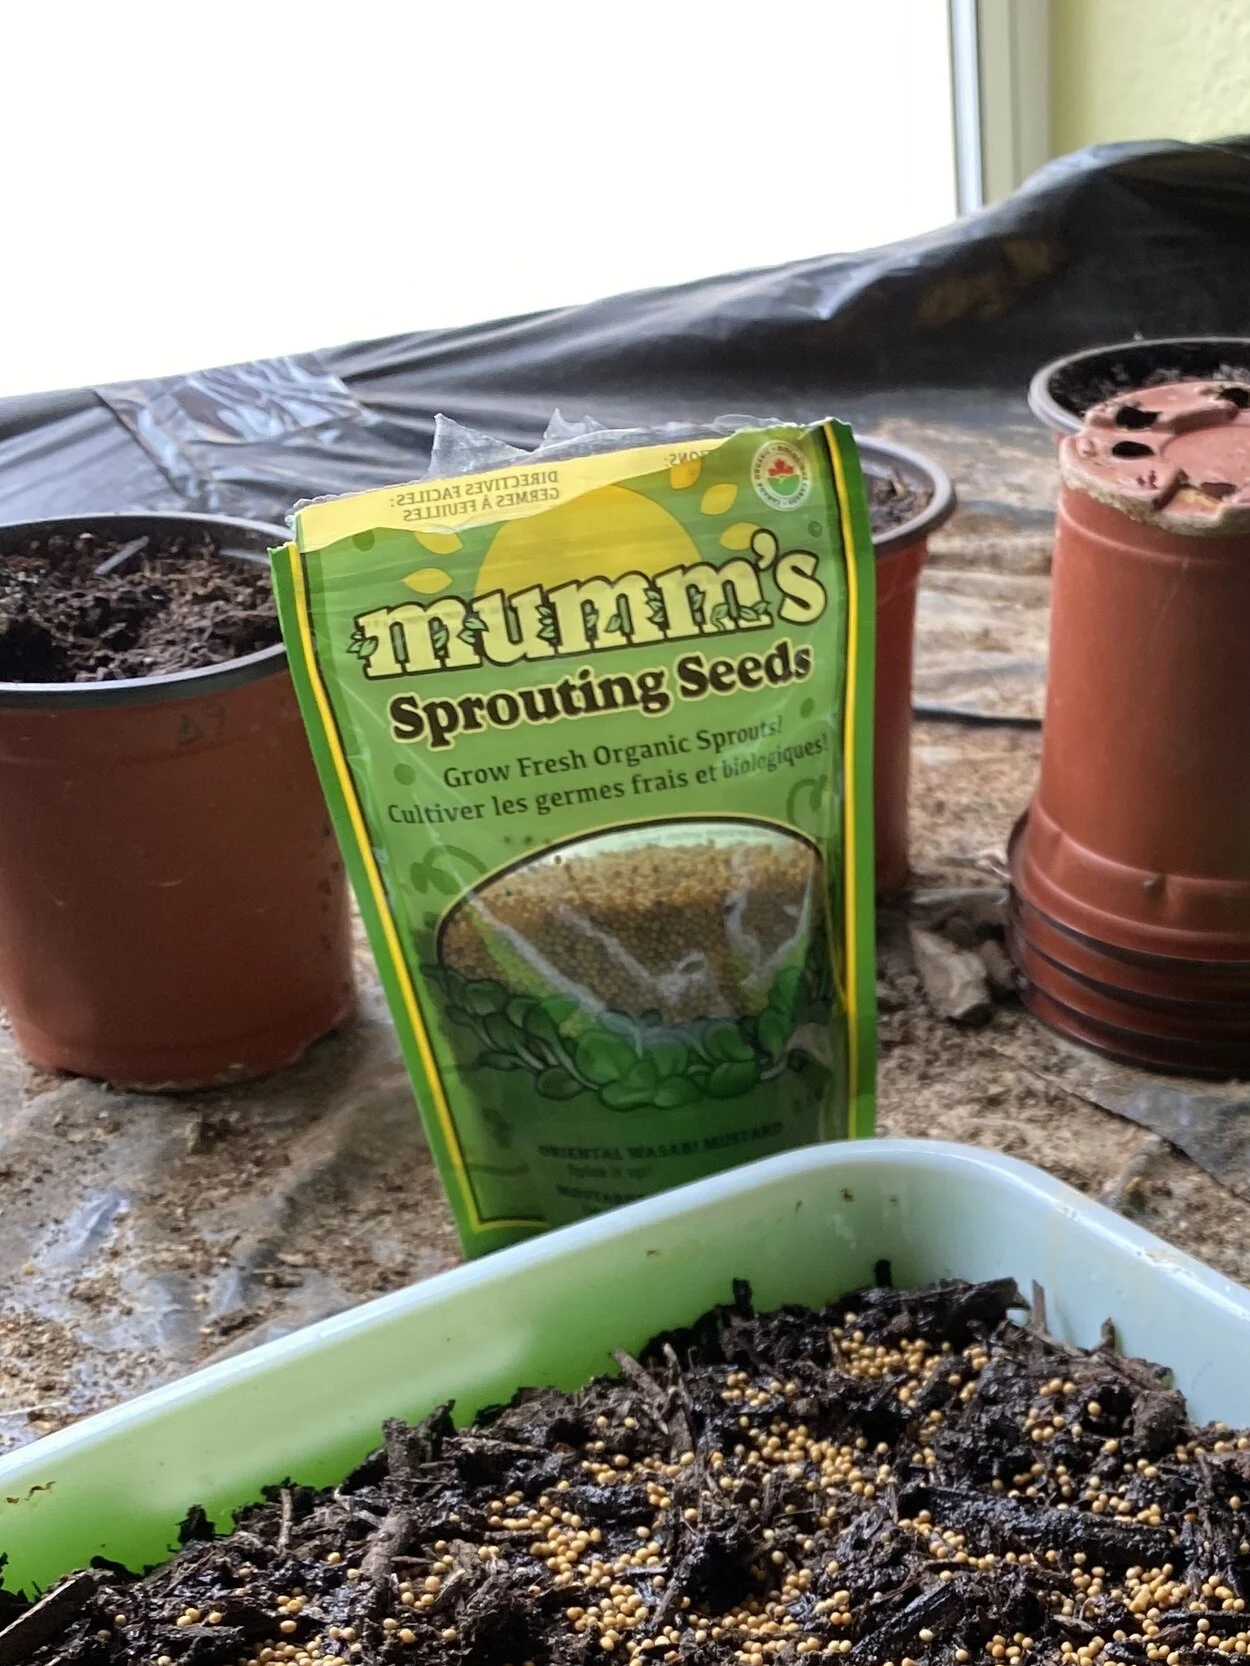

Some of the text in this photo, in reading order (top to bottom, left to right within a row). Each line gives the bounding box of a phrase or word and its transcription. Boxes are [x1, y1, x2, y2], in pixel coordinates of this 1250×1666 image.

[352, 528, 827, 680] mumm's
[390, 644, 811, 748] Sprouting Seeds
[387, 733, 828, 824] Cultiver les germes frais et biologiques!
[443, 715, 782, 788] Grow Fresh Organic Sprouts!
